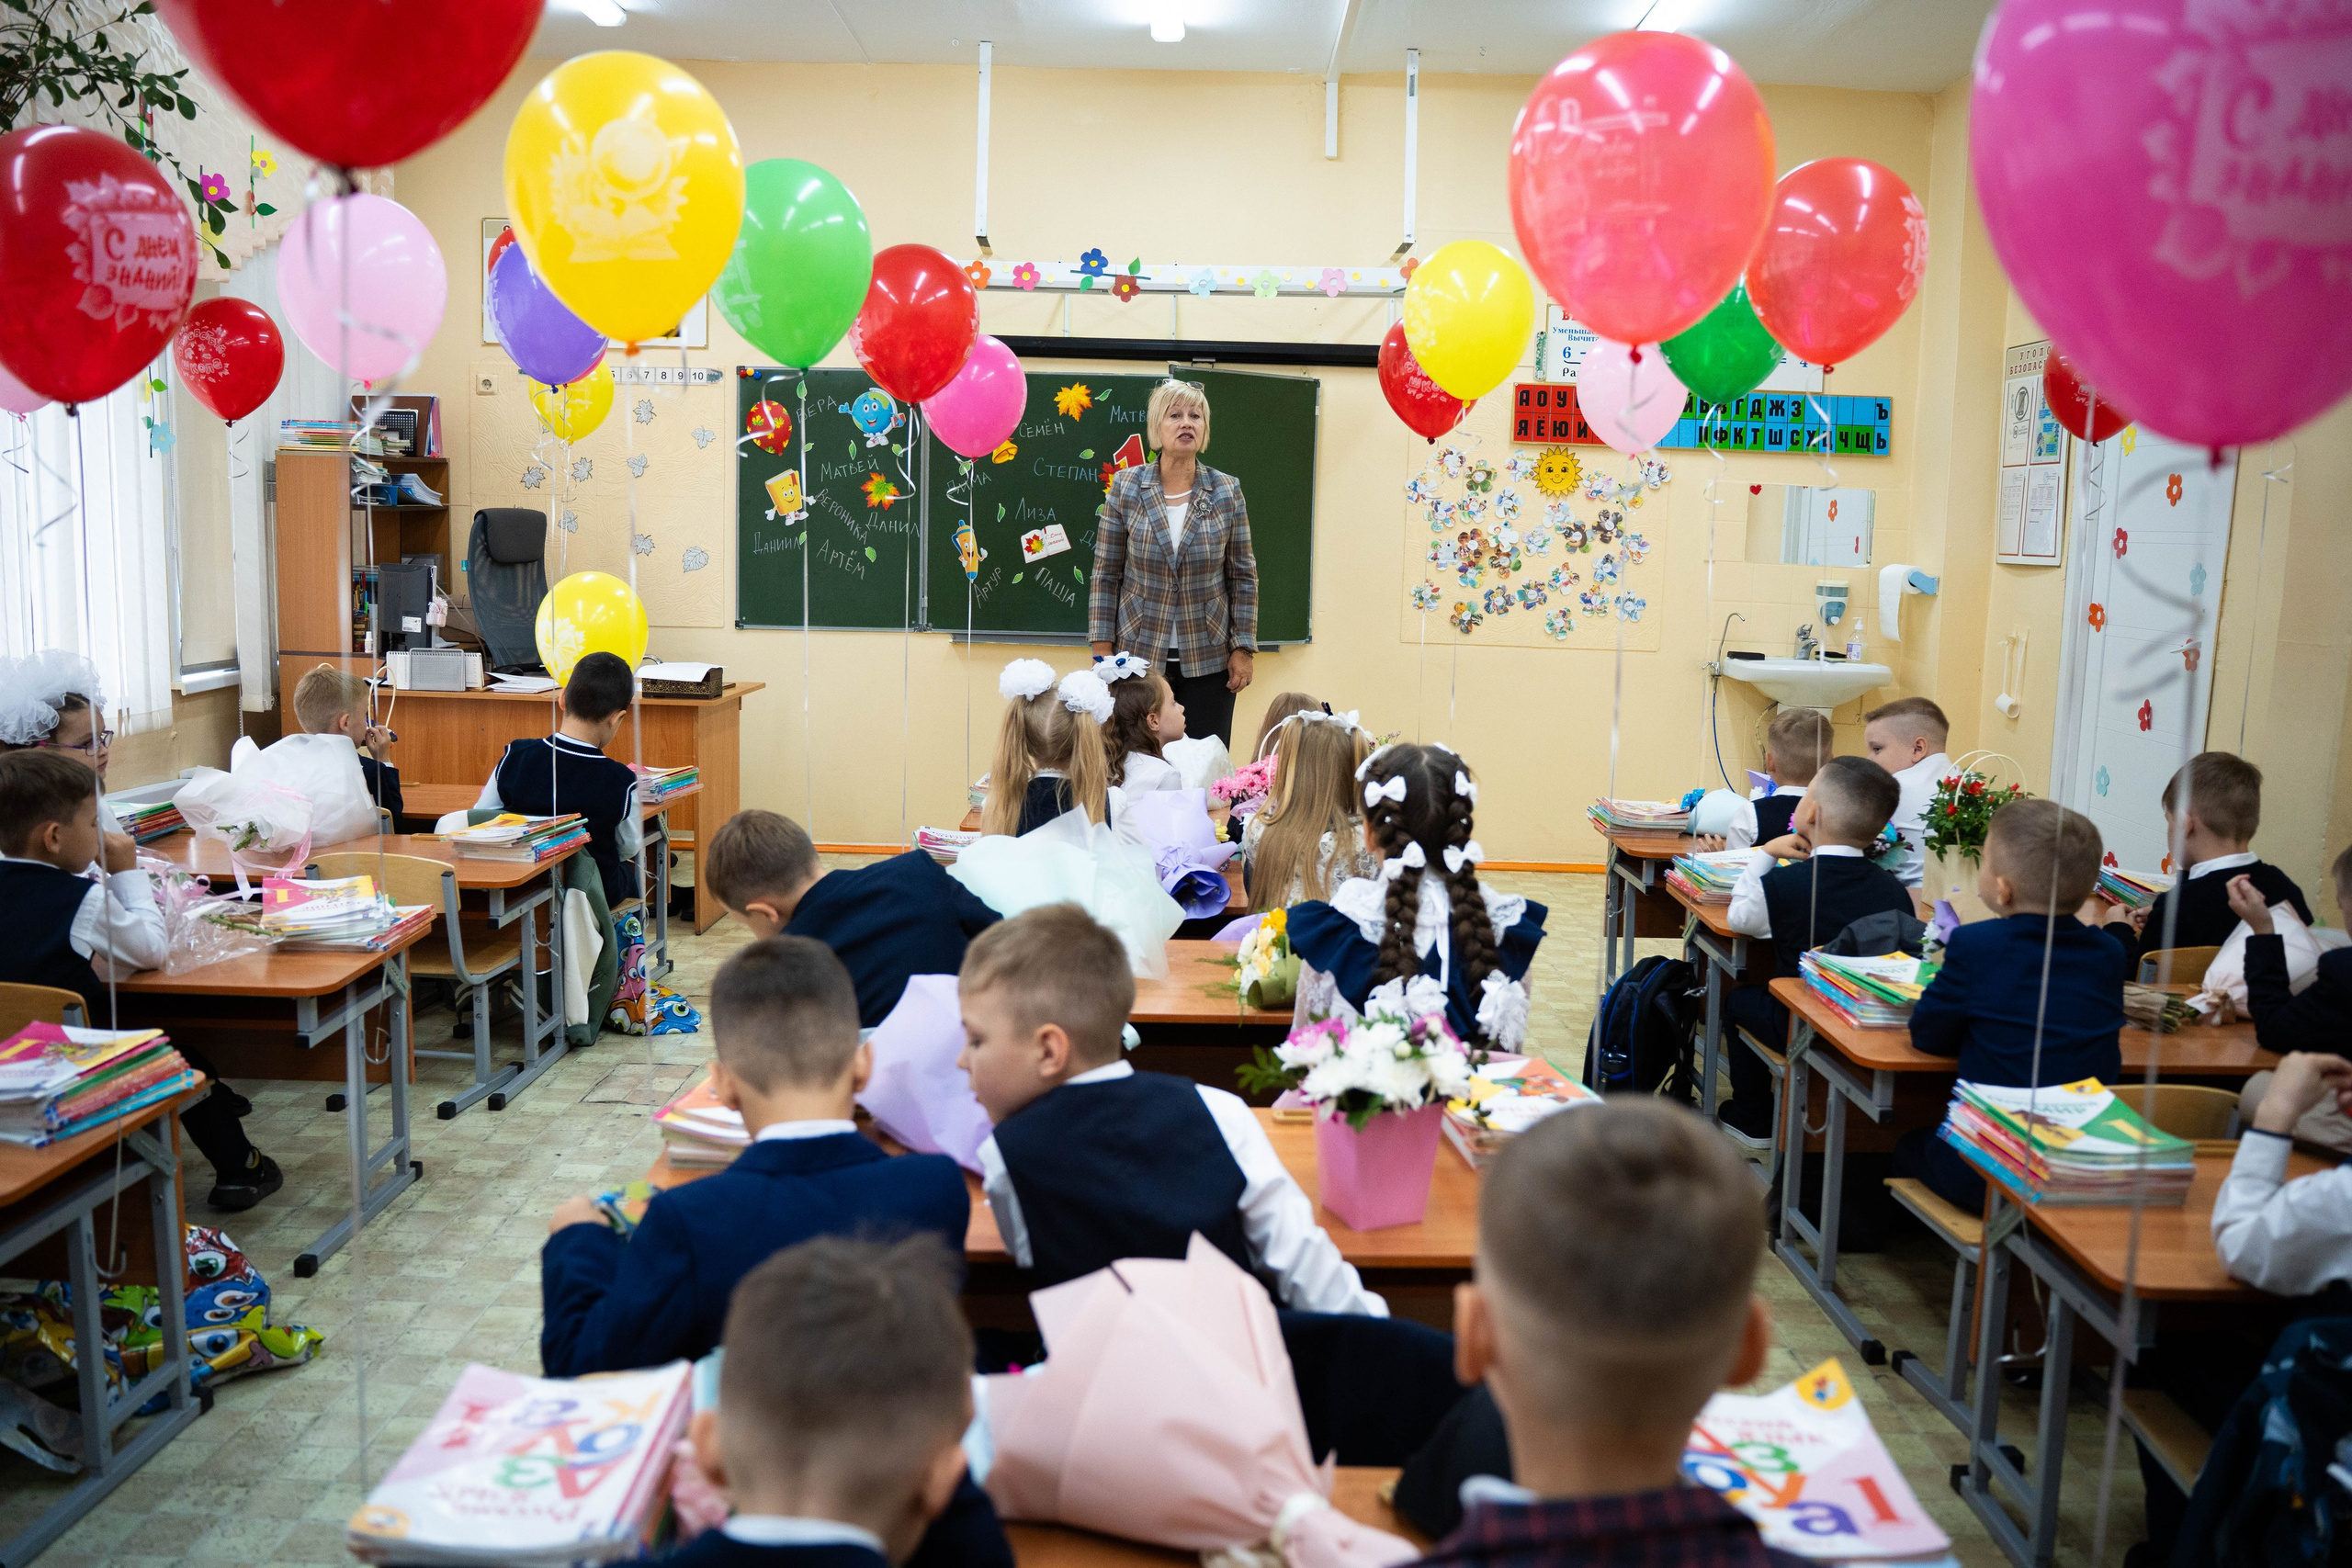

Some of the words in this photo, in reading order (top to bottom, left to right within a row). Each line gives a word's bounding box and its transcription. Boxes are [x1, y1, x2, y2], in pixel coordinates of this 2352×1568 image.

[104, 227, 126, 262] С
[1563, 346, 1572, 358] 6
[2019, 345, 2052, 361] УГОЛО
[644, 371, 650, 379] 7
[661, 371, 667, 380] 8
[677, 371, 684, 380] 9
[692, 372, 704, 380] 10
[2009, 359, 2047, 376] БЕЗОПАС
[1110, 405, 1149, 424] МАТВ
[1537, 390, 1547, 408] О
[1557, 391, 1567, 409] У
[1750, 399, 1762, 419] Д
[1769, 400, 1785, 417] Ж
[1791, 400, 1802, 418] З
[1876, 403, 1889, 421] Ъ
[1517, 419, 1529, 436] Я
[1536, 416, 1545, 437] Ё
[1553, 420, 1569, 438] Ю
[1577, 421, 1589, 439] И
[1713, 426, 1728, 444] Ф
[1734, 427, 1744, 445] К
[1751, 428, 1760, 445] Т
[1769, 428, 1782, 446] Ш
[1790, 429, 1800, 446] С
[1839, 431, 1849, 448] Ч
[1856, 432, 1871, 453] Щ
[1876, 433, 1887, 449] Ь
[1843, 1474, 1917, 1529] 1
